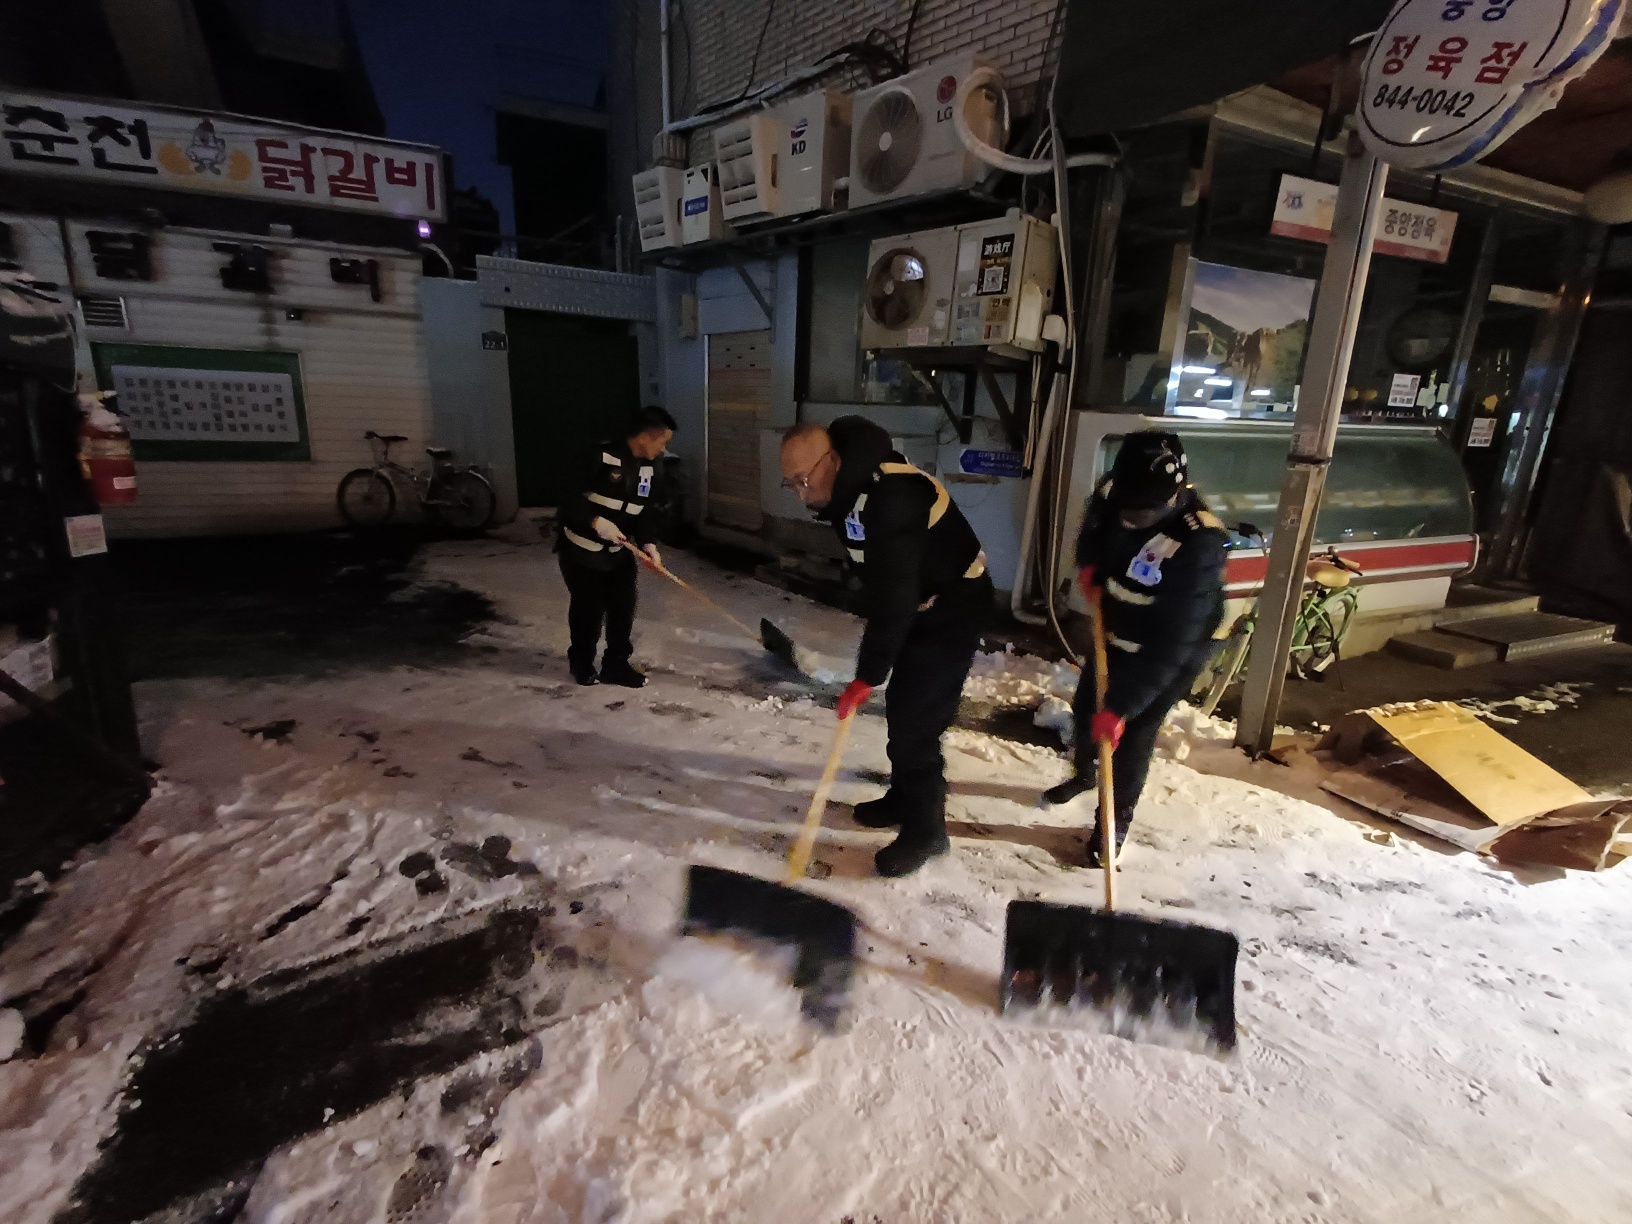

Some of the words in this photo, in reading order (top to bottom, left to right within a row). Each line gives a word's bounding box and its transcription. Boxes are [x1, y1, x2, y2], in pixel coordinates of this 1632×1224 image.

[1382, 34, 1529, 84] 정육점
[936, 106, 953, 123] LG
[1372, 83, 1475, 118] 844-0042
[791, 139, 807, 156] KD
[255, 137, 436, 211] 닭갈비
[1384, 208, 1438, 242] 중앙정육
